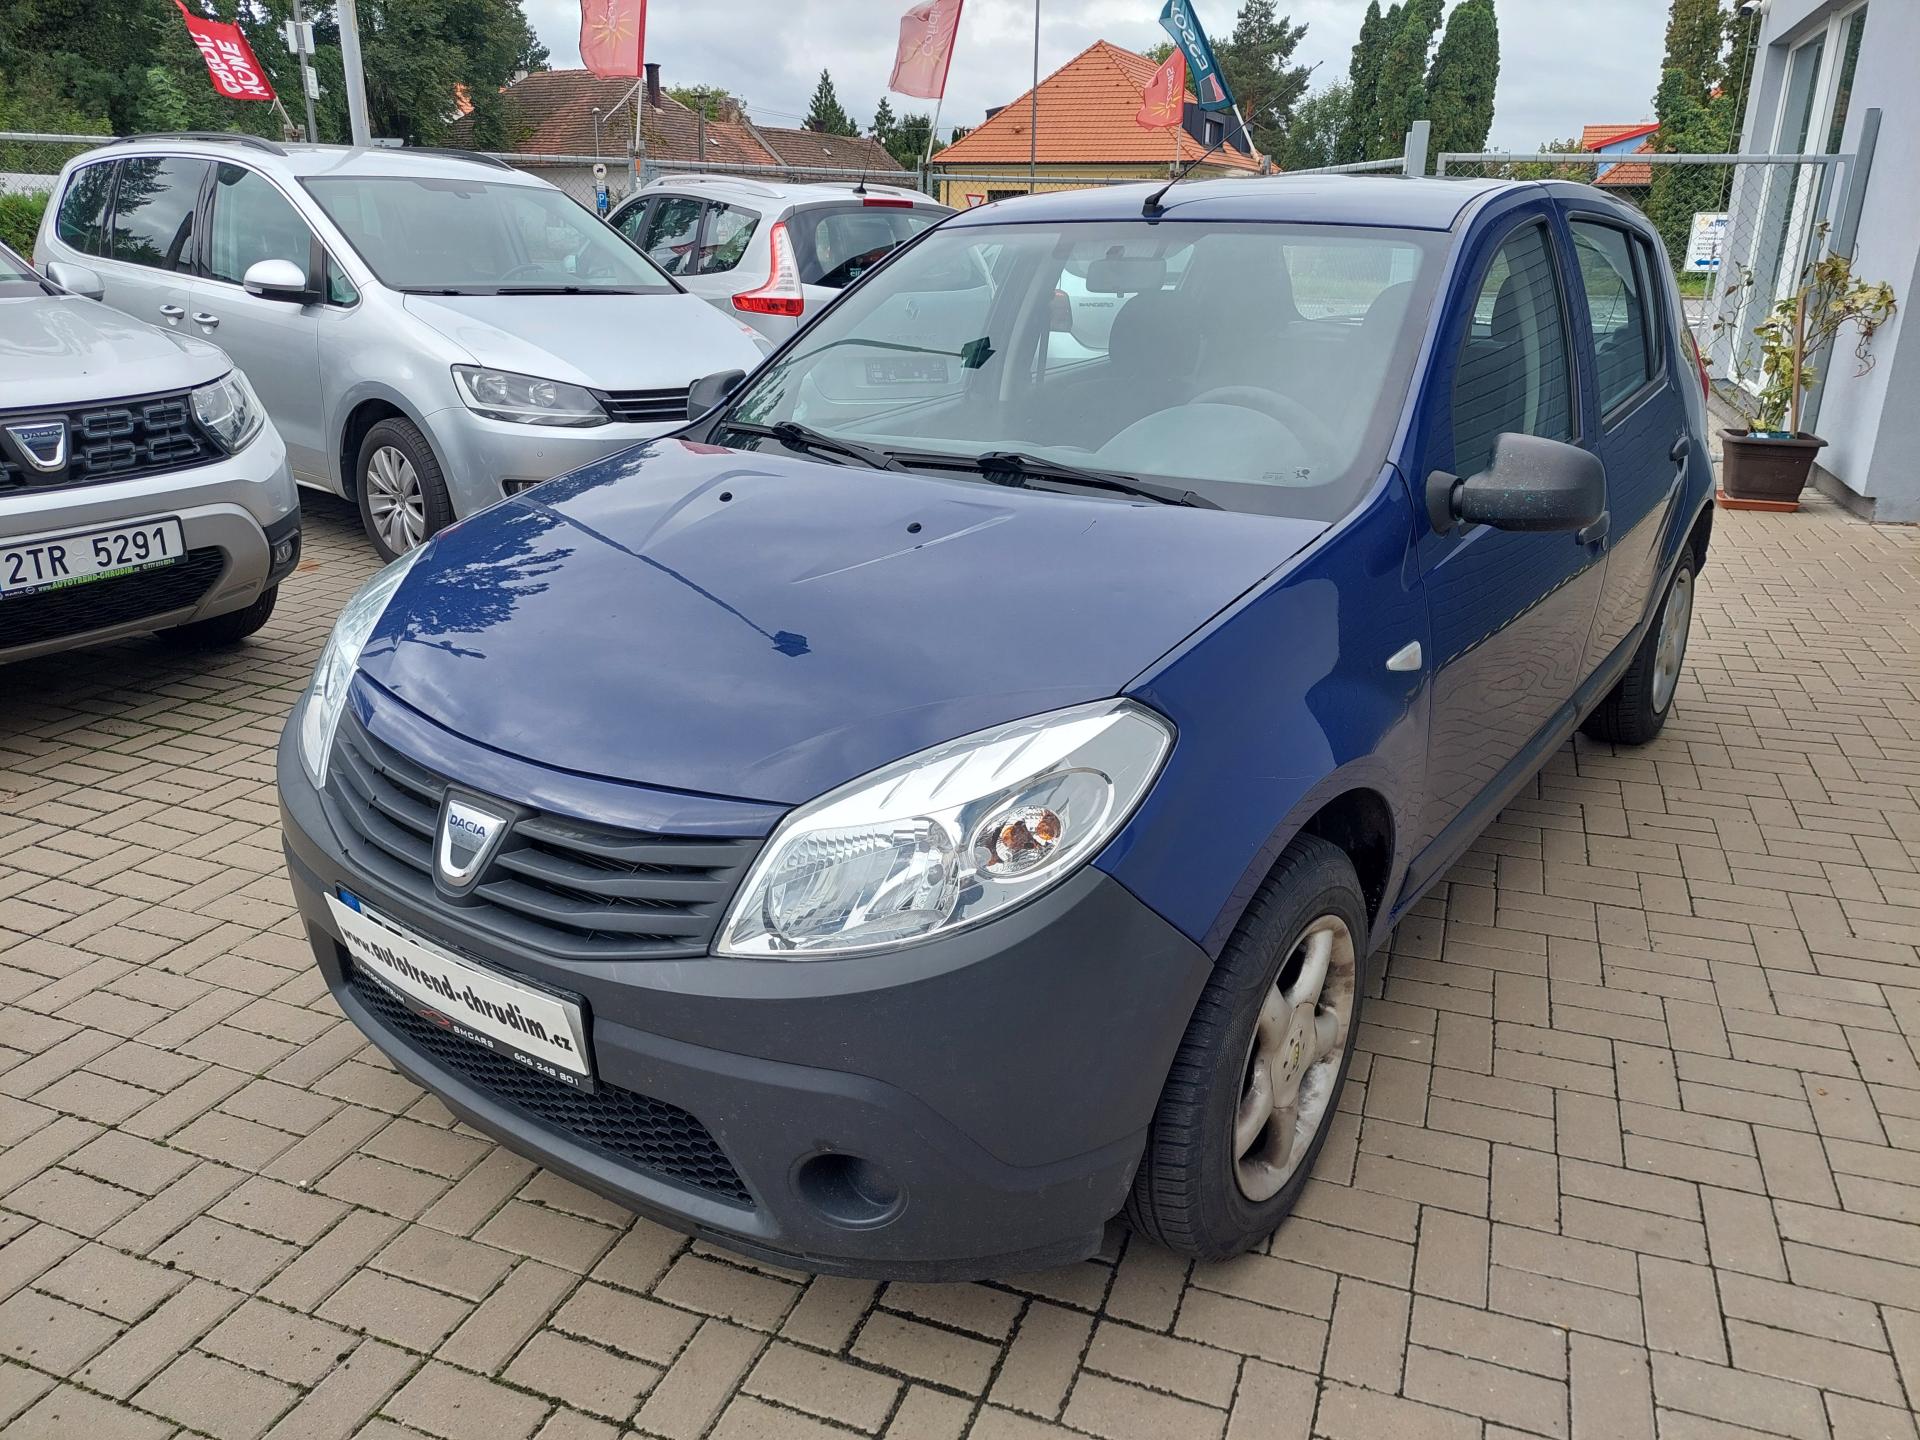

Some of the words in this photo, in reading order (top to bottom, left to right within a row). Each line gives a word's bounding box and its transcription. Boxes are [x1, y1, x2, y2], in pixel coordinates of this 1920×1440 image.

[598, 193, 605, 204] P
[21, 430, 60, 440] DACIA
[4, 545, 70, 585] 2TR
[92, 527, 168, 568] 5291
[449, 814, 486, 838] DACIA
[339, 925, 574, 1053] www.autotrend-chrudim.cz
[452, 1025, 495, 1049] SMCARS
[513, 1051, 533, 1067] 606
[536, 1061, 556, 1077] 248
[559, 1071, 579, 1087] 801
